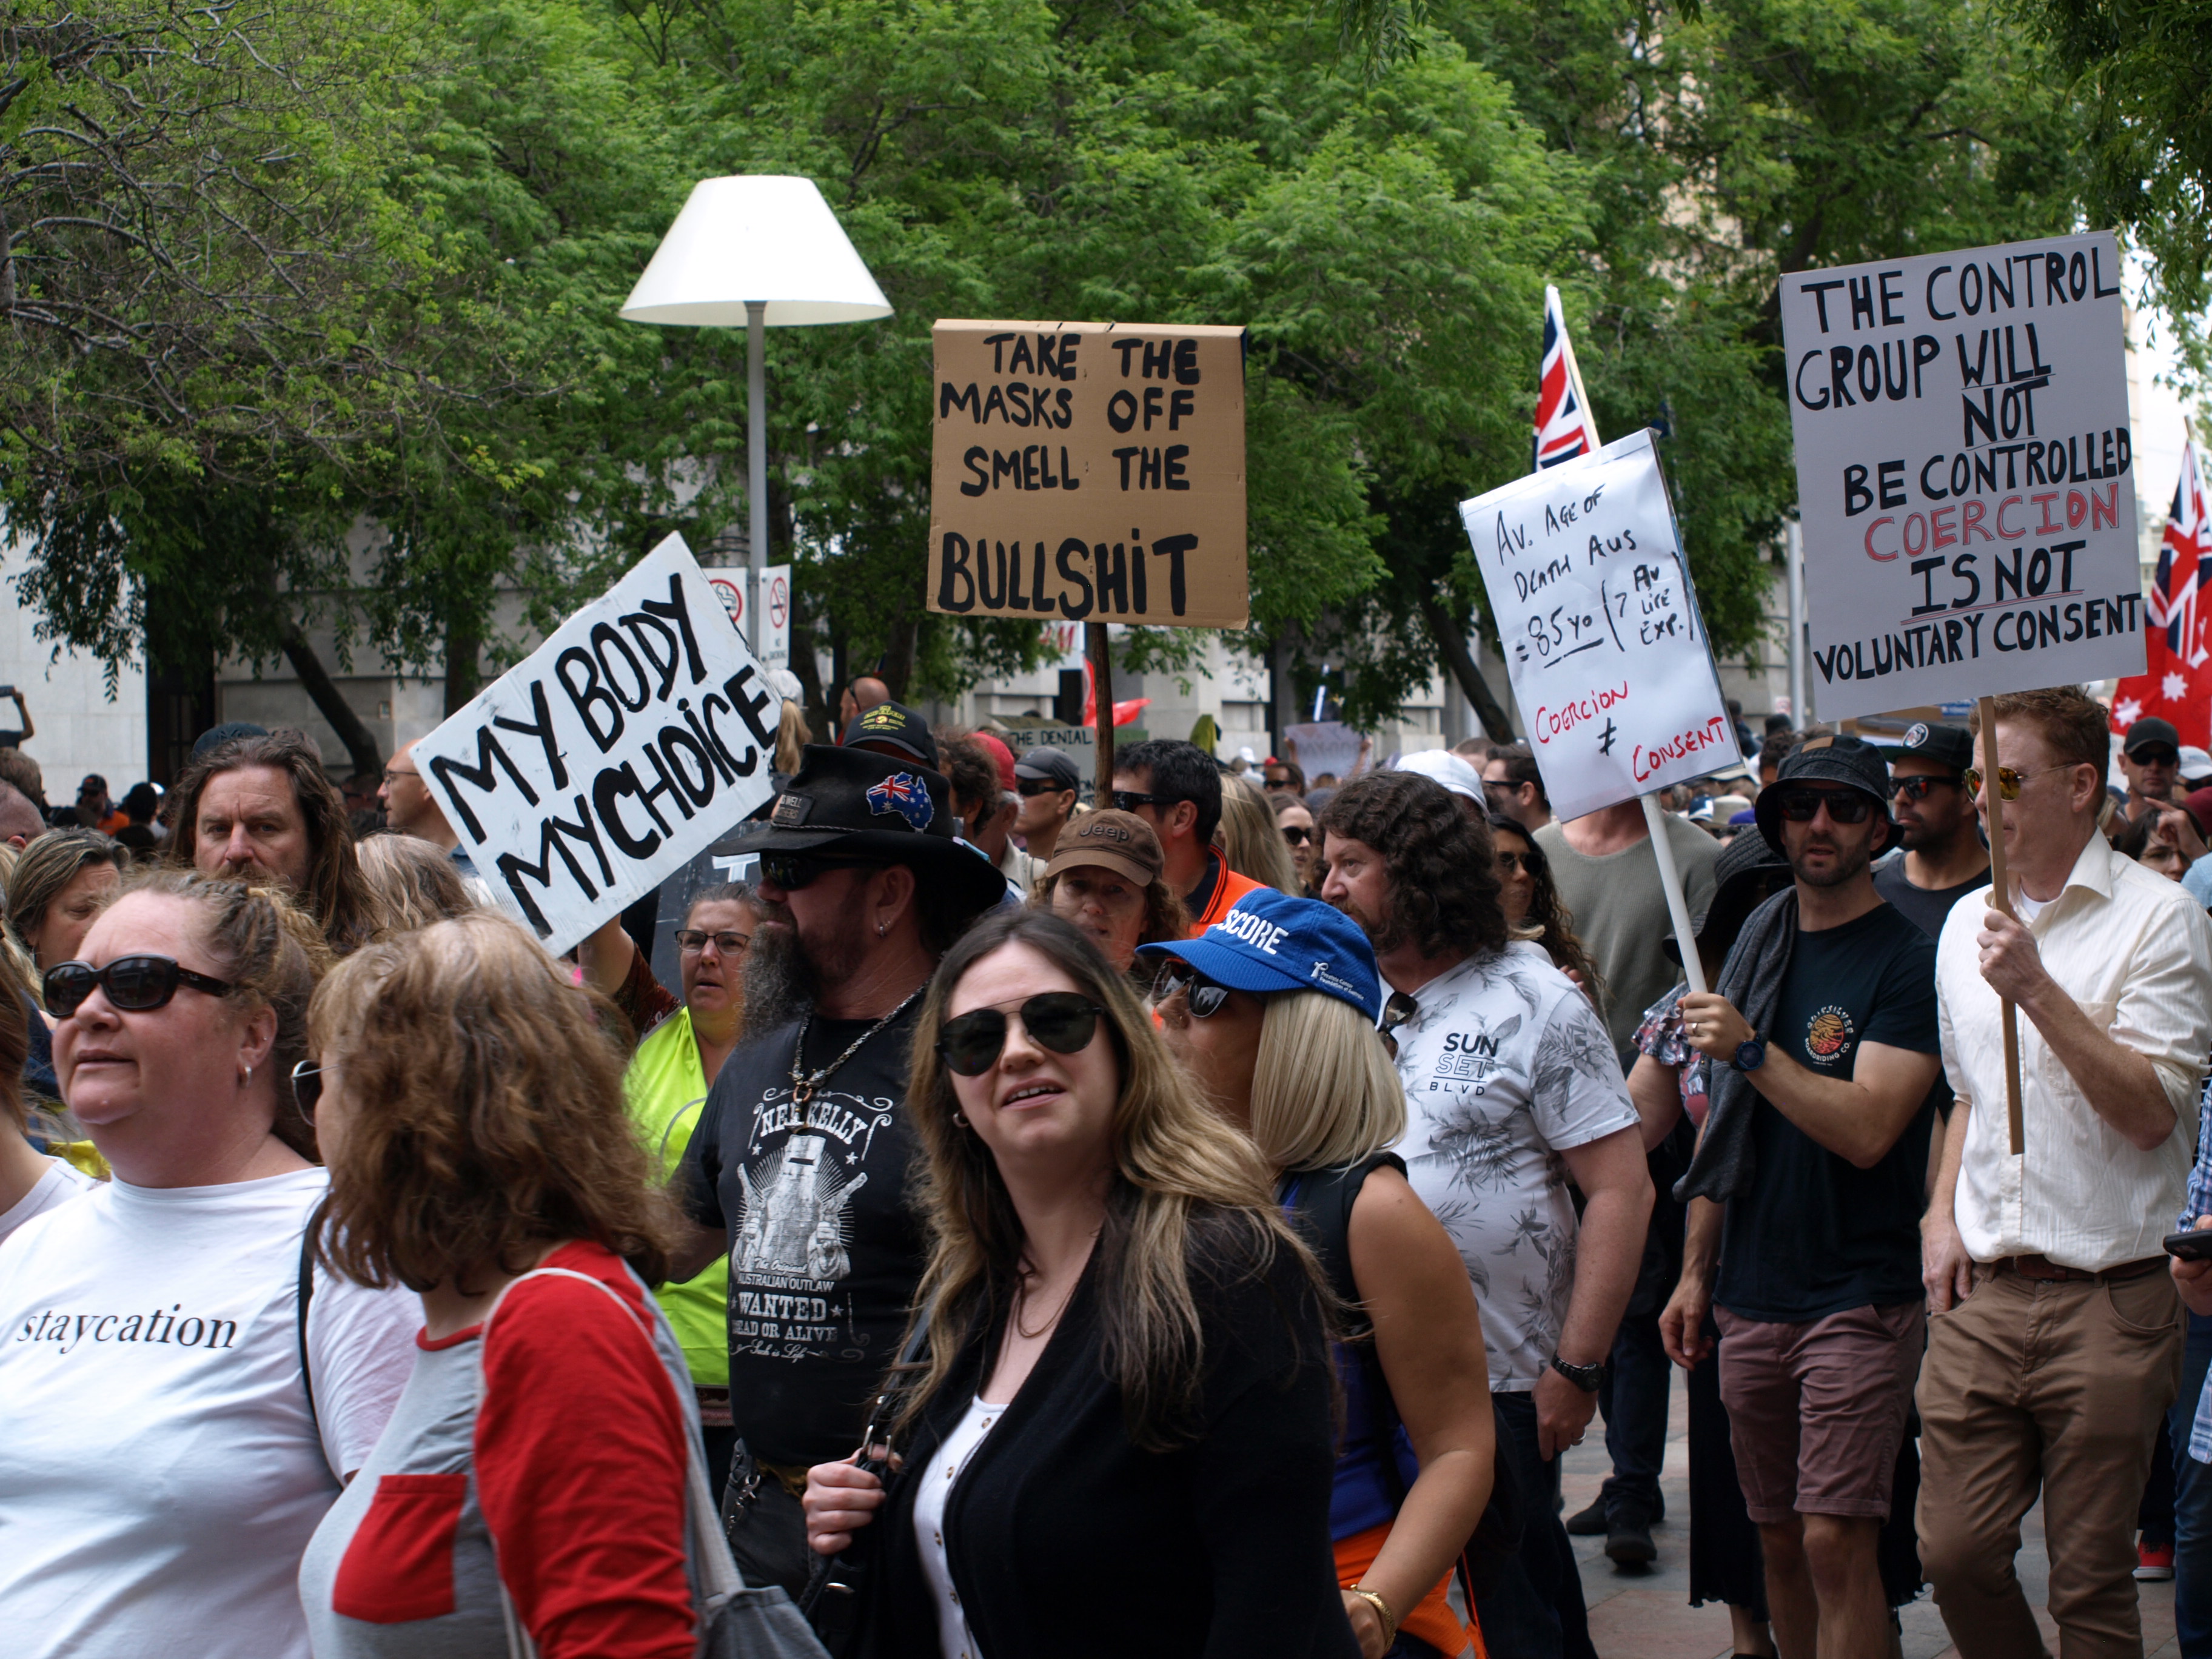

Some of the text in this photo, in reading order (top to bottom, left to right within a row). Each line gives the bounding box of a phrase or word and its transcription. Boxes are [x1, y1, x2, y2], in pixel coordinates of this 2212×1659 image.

[1801, 247, 2120, 333] THE CONTROL
[984, 333, 1199, 385] TAKE THE
[1795, 323, 2052, 411] GROUP WILL
[940, 382, 1194, 433] MASKS OFF
[1962, 375, 2050, 448] NOT
[960, 444, 1190, 497] SMELL THE
[1844, 427, 2131, 516] BE CONTROLLED
[1546, 504, 1578, 537] AGE
[1584, 483, 1606, 513] OF
[1865, 483, 2119, 561] COERCION
[1911, 540, 2086, 616] IS NOT
[1813, 592, 2142, 684] VOLUNTARY CONSENT
[429, 572, 708, 845] MY BODY
[1010, 729, 1093, 745] THE DENIAL
[1632, 717, 1724, 782] CONSENT
[1080, 822, 1129, 842] Jeep
[1216, 909, 1289, 955] SCORE
[1435, 1053, 1495, 1078] SET
[1443, 1033, 1499, 1057] SUN
[1429, 1082, 1485, 1096] BLVD
[806, 1101, 868, 1144] KELLY
[737, 1272, 834, 1292] AUSTRALIAN OUTLAW
[754, 1256, 808, 1274] The Original
[17, 1304, 237, 1354] staycation
[739, 1292, 826, 1321] WANTED
[762, 1322, 780, 1338] OR
[784, 1326, 837, 1342] ALIVE
